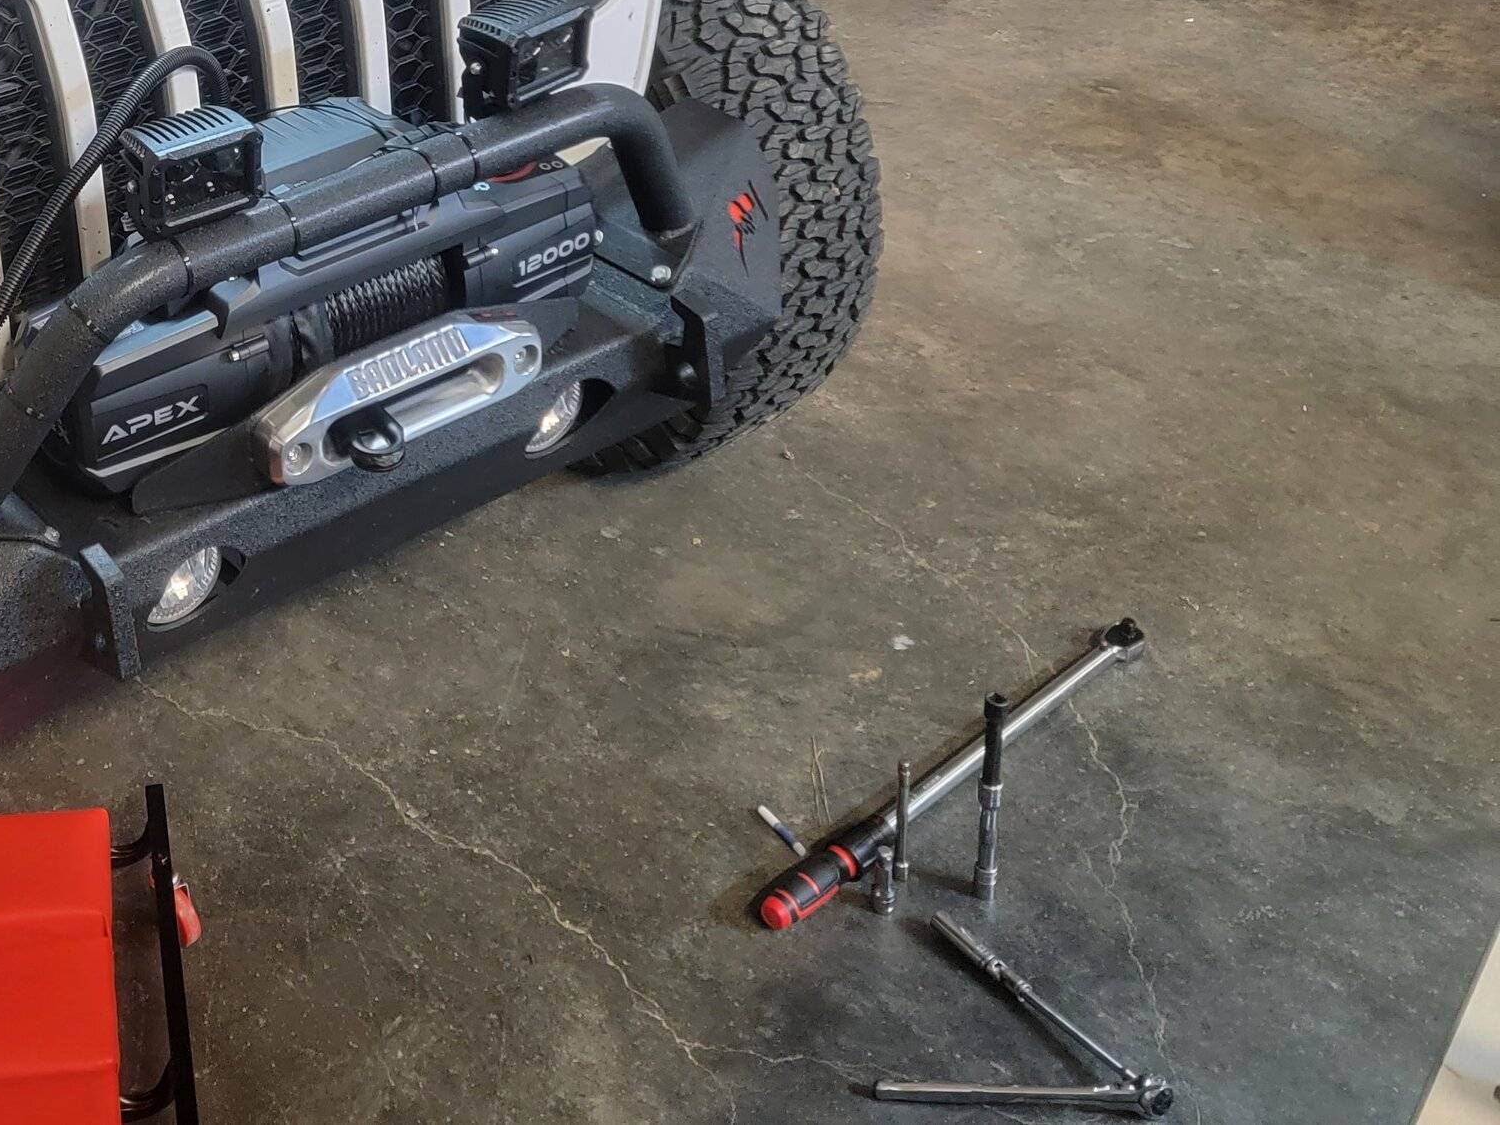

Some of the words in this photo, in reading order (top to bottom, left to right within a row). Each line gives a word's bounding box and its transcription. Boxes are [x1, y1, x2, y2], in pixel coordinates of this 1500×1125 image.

[518, 232, 591, 277] 12000
[343, 324, 470, 401] BADLAND
[100, 394, 200, 446] APEX
